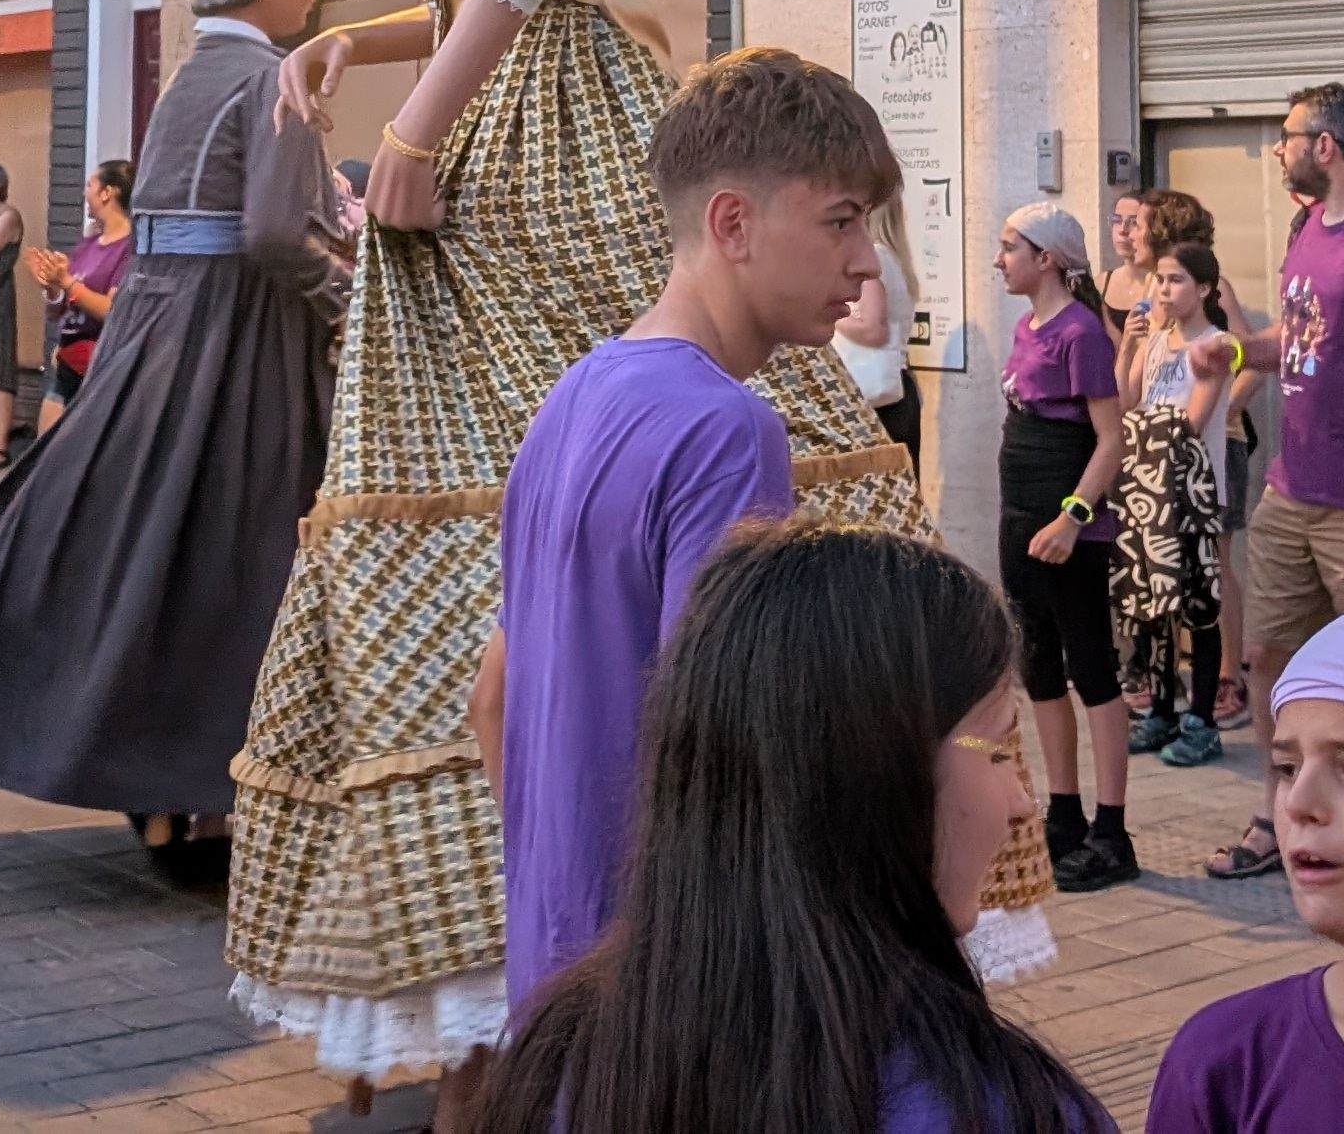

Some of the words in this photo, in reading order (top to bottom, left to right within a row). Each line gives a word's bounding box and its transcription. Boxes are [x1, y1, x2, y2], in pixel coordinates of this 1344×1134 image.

[857, 0, 889, 13] FOTOS
[857, 15, 897, 30] CARNET
[882, 87, 932, 106] Fotocòpies
